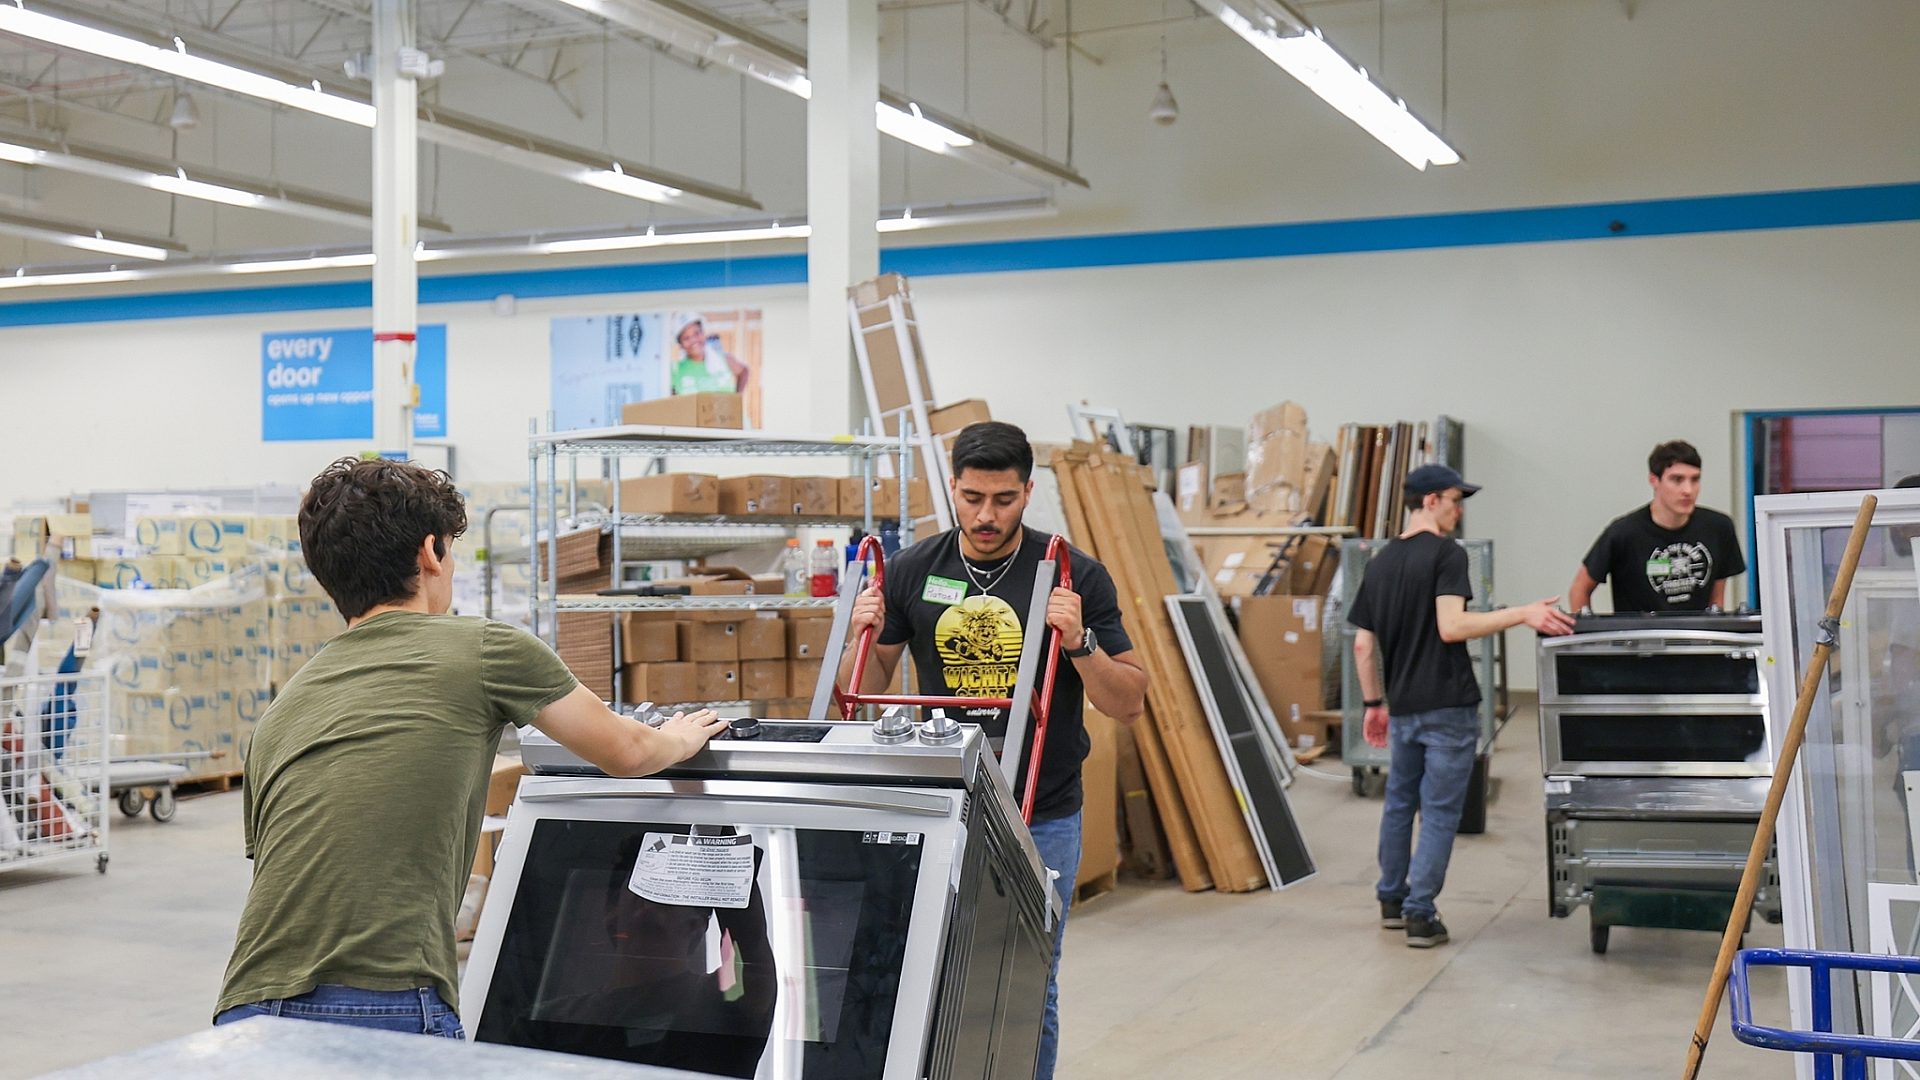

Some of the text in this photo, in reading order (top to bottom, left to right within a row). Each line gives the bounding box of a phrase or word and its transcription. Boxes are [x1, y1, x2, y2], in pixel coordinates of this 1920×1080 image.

[268, 337, 333, 361] every
[268, 363, 322, 388] door
[189, 519, 223, 553] Q
[943, 665, 1018, 688] WICHITA
[703, 838, 737, 846] WARNING
